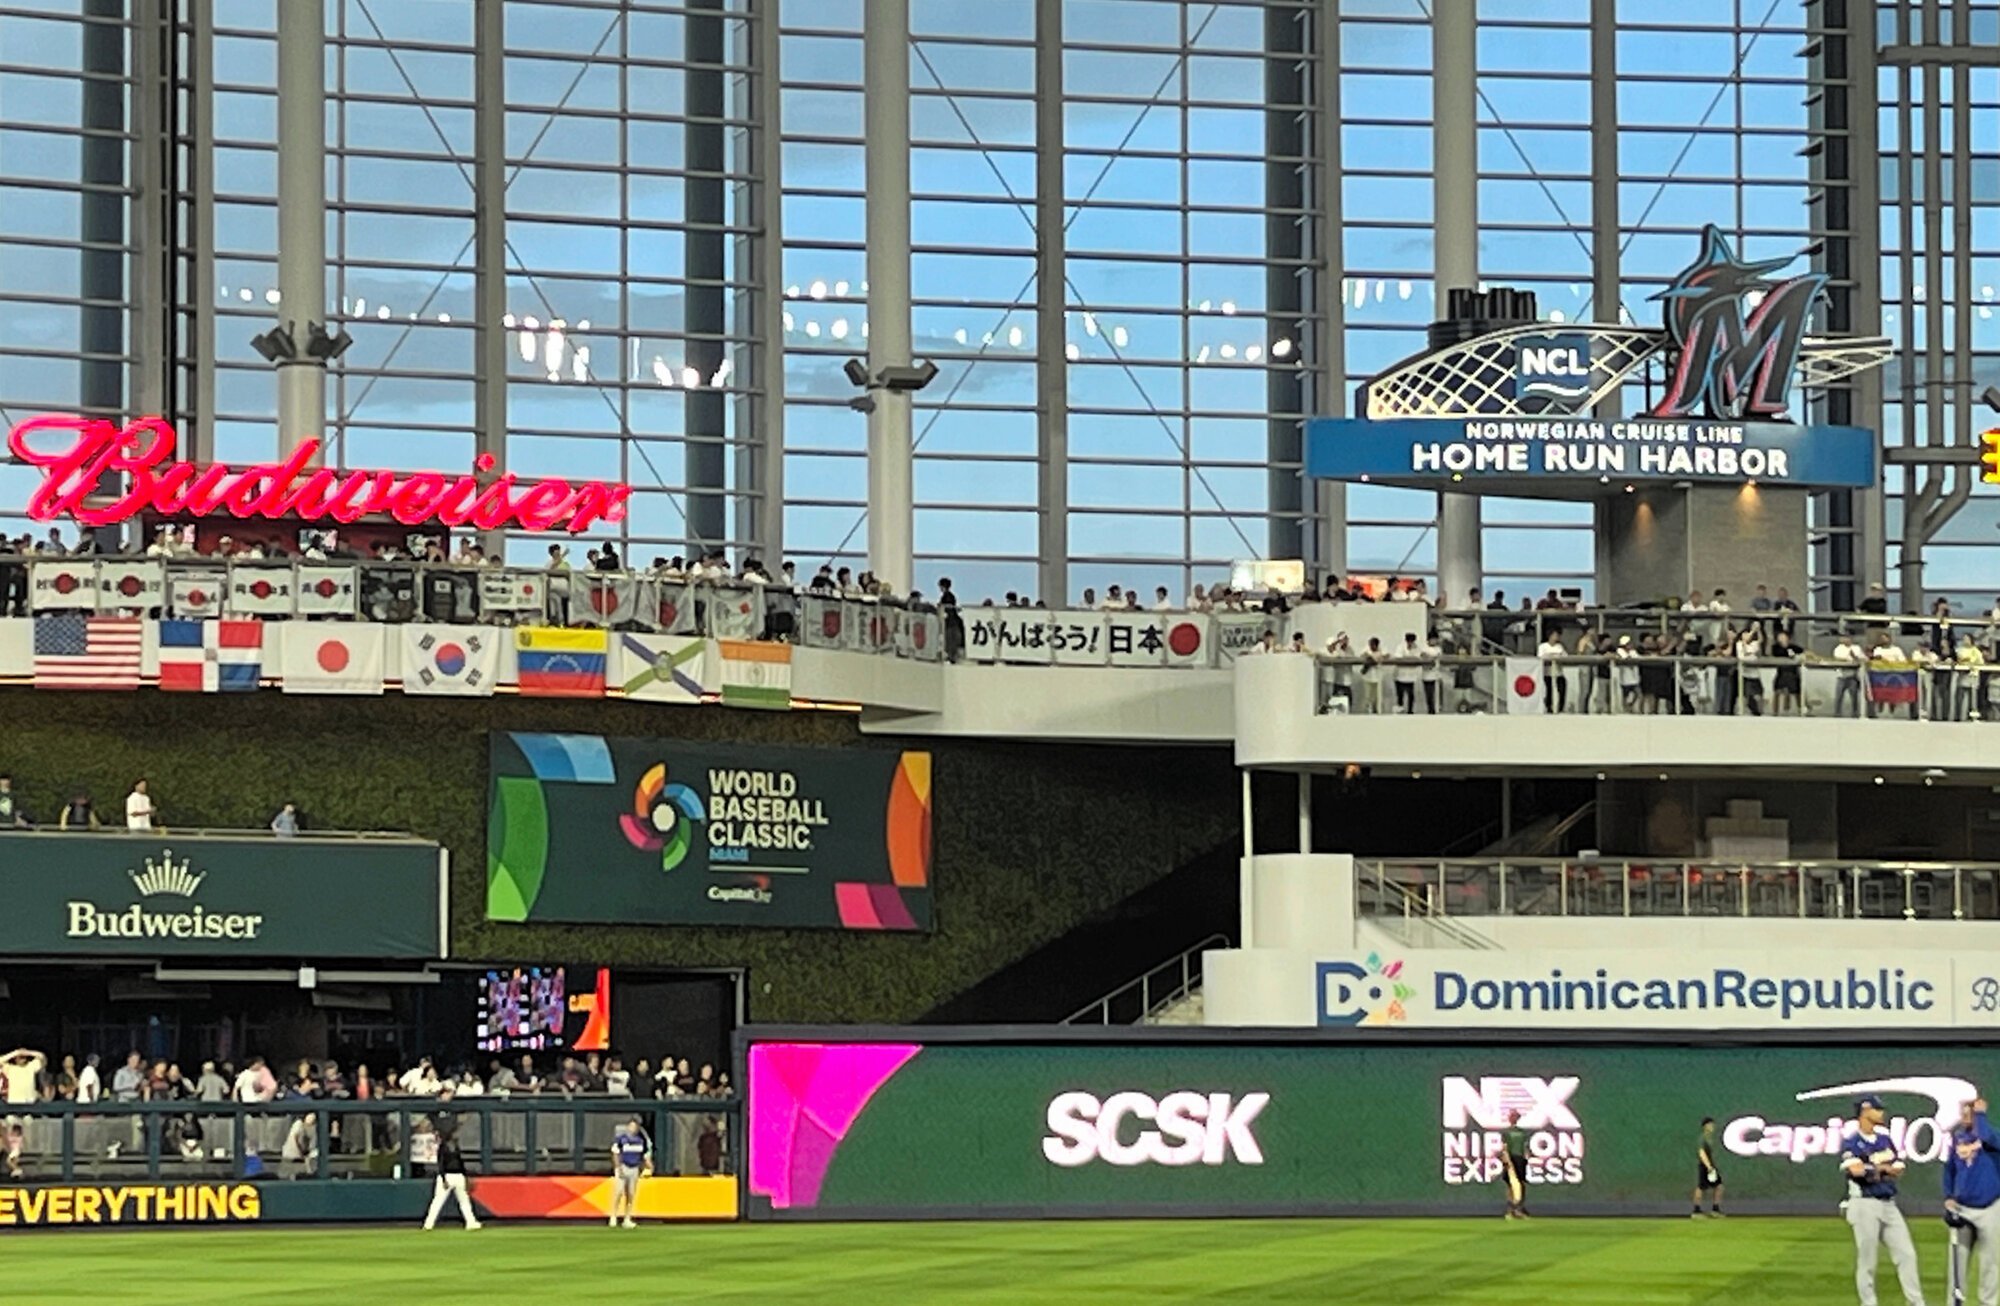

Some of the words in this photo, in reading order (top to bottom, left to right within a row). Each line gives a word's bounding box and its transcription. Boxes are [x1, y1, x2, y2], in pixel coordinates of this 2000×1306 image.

[1522, 348, 1590, 376] NCL
[1466, 422, 1601, 440] NORWEGIAN
[1611, 424, 1691, 443] CRUISE
[1695, 424, 1744, 445] LINE
[9, 416, 632, 532] Budweiser
[1412, 443, 1529, 471] HOME
[1544, 443, 1628, 472] RUN
[1640, 444, 1789, 477] HARBOR
[708, 769, 796, 796] WORLD
[709, 797, 829, 825] BASEBALL
[708, 822, 810, 849] CLASSIC
[67, 901, 262, 939] Budweiser
[1042, 1091, 1270, 1166] SCSK
[1443, 1131, 1583, 1158] NIPON
[1443, 1158, 1583, 1184] EXPESS
